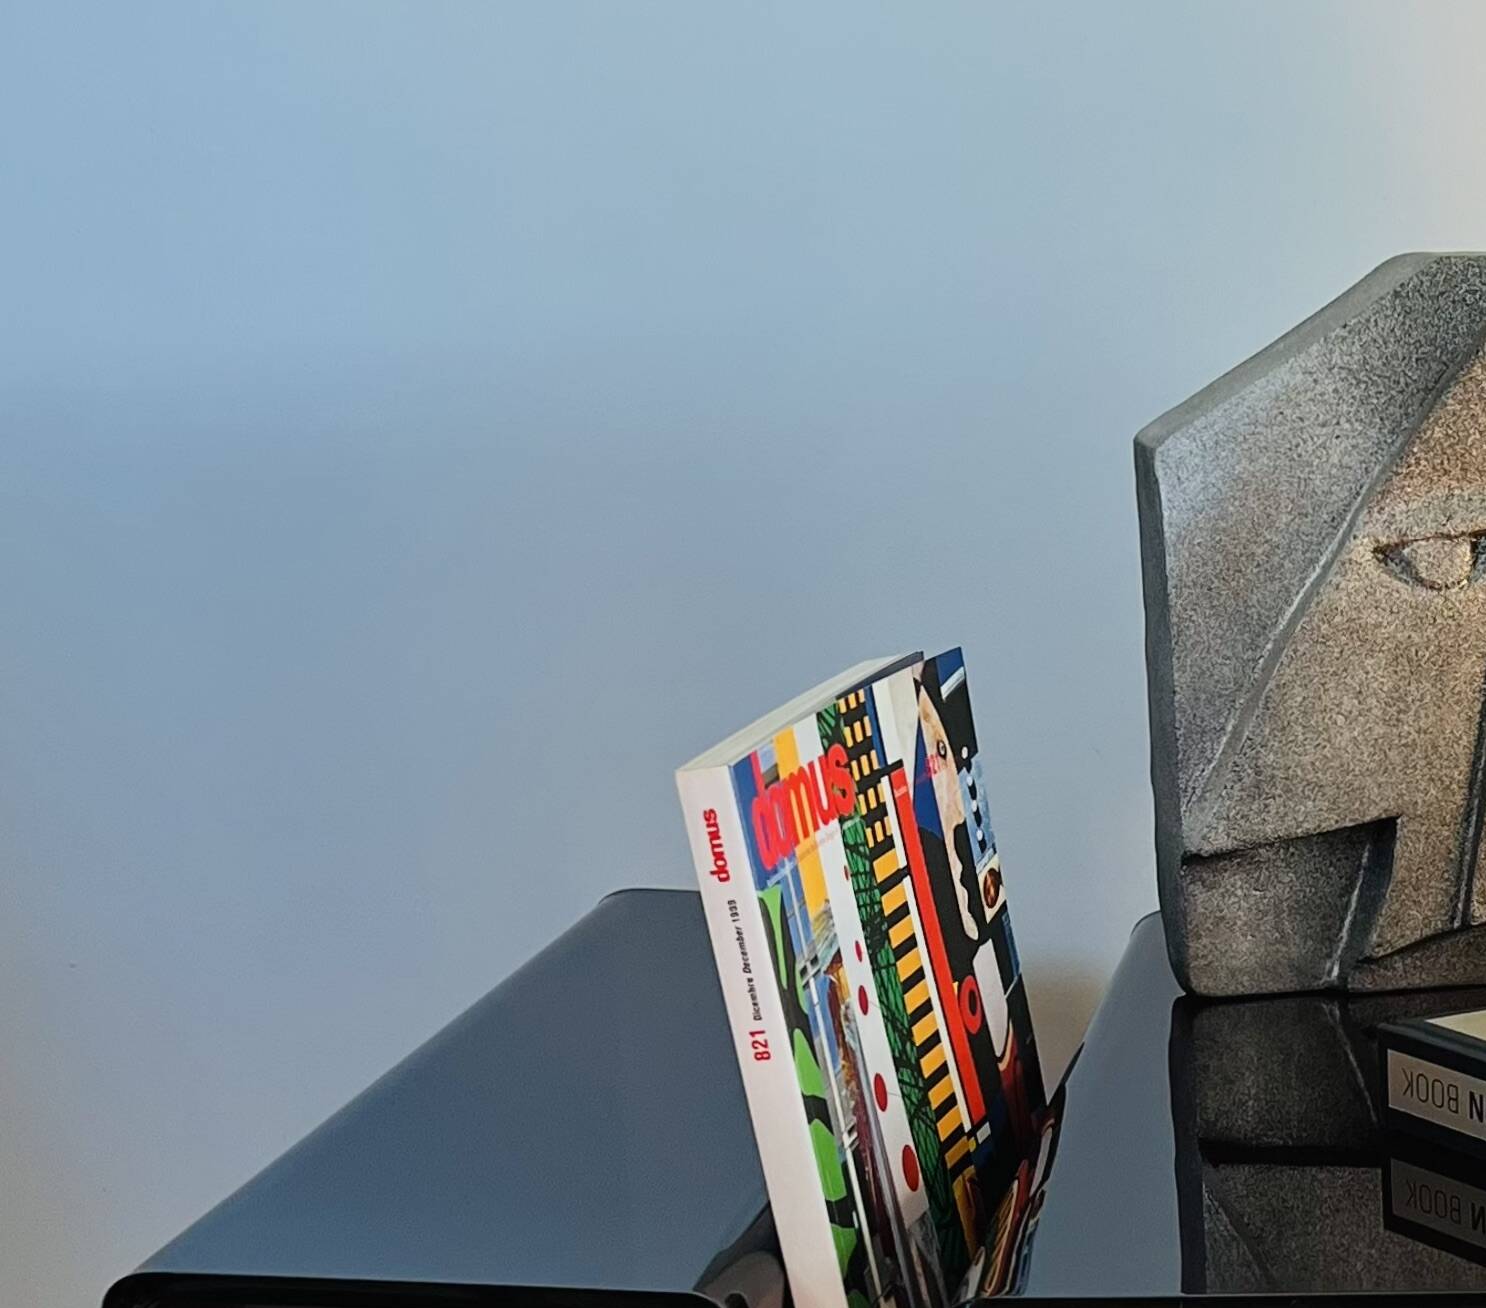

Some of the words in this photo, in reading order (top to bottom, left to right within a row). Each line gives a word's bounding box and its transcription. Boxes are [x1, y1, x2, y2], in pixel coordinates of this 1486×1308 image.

[750, 744, 856, 870] domus
[703, 808, 730, 883] domus
[727, 900, 740, 922] 1999
[735, 926, 752, 974] December
[749, 1029, 771, 1061] 821
[1402, 1067, 1459, 1114] BOOK
